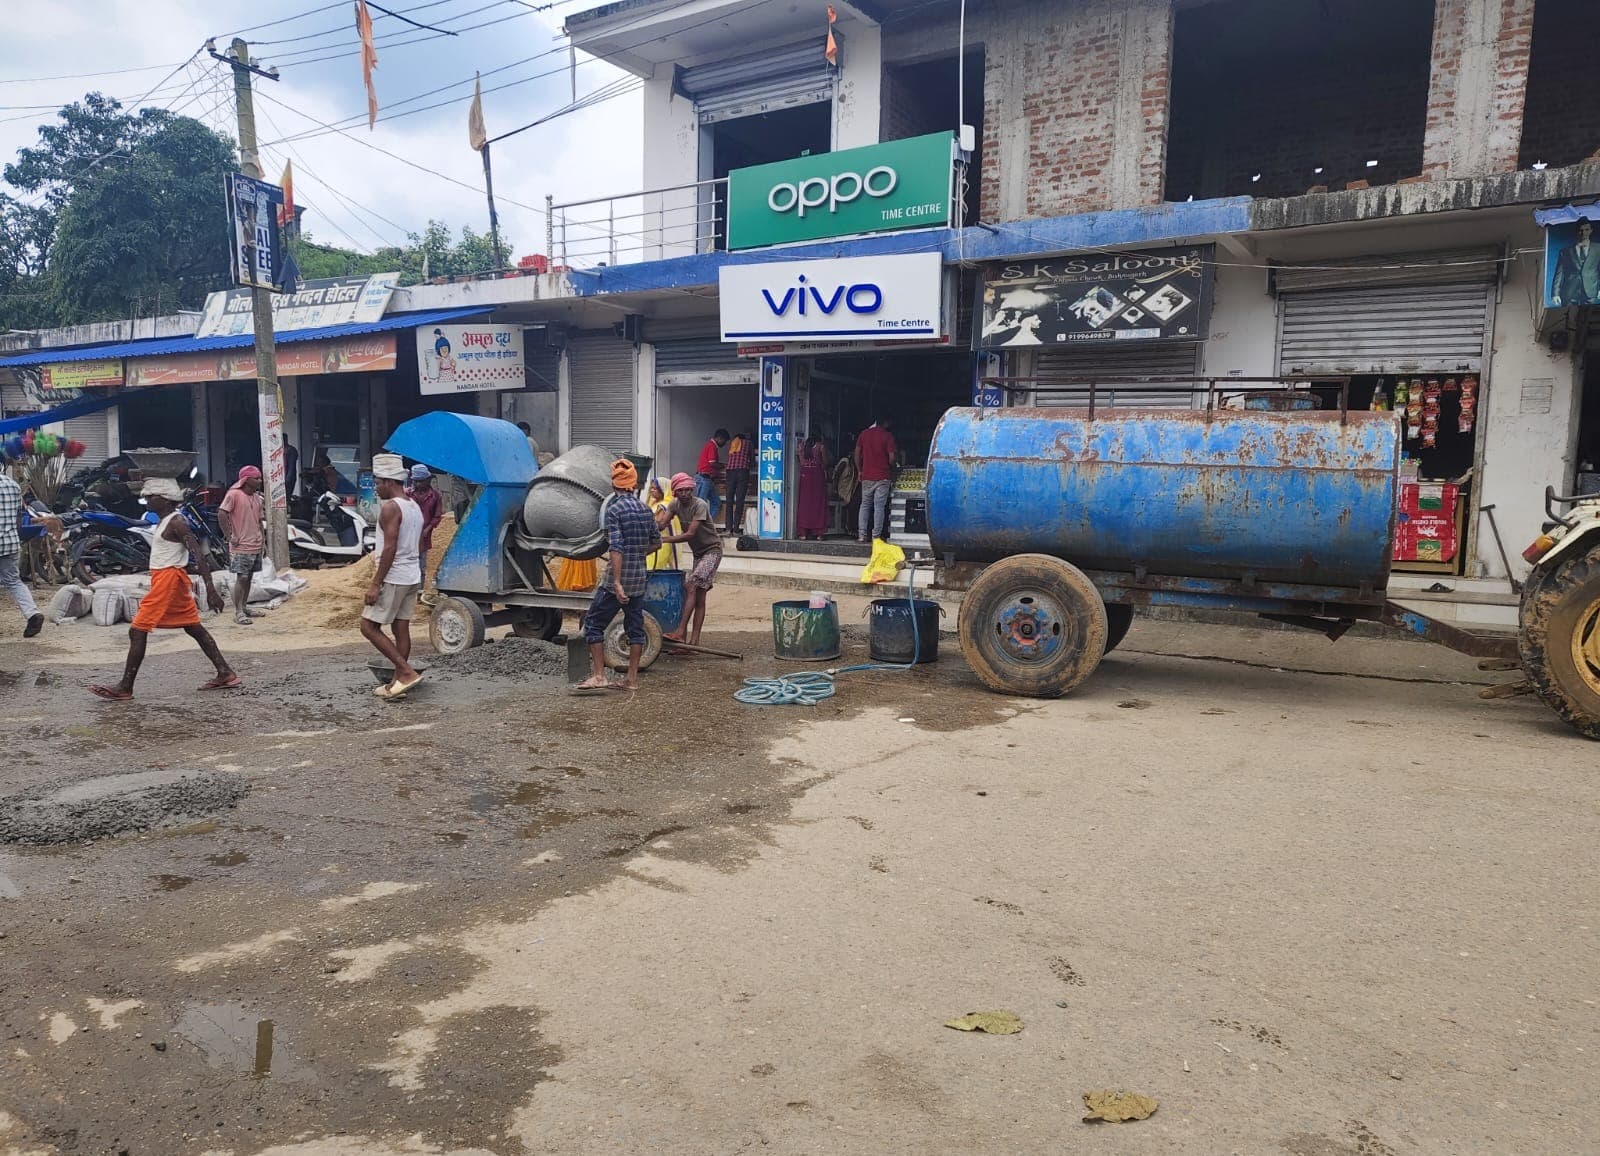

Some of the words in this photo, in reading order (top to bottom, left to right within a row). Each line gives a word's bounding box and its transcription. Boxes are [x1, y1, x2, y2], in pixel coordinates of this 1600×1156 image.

[768, 165, 897, 217] oppo
[881, 207, 903, 220] TIME
[906, 203, 941, 217] CENTRE
[1063, 254, 1191, 276] Saloon
[326, 283, 362, 303] होटल
[761, 274, 882, 316] vivo
[878, 320, 899, 328] Time
[901, 318, 930, 327] Centre
[462, 332, 494, 349] अमूल
[495, 331, 511, 347] दूध
[301, 361, 319, 369] HOTEL
[762, 402, 783, 412] 0%
[762, 433, 772, 442] दर
[762, 446, 782, 461] लोन
[760, 476, 782, 494] फोन
